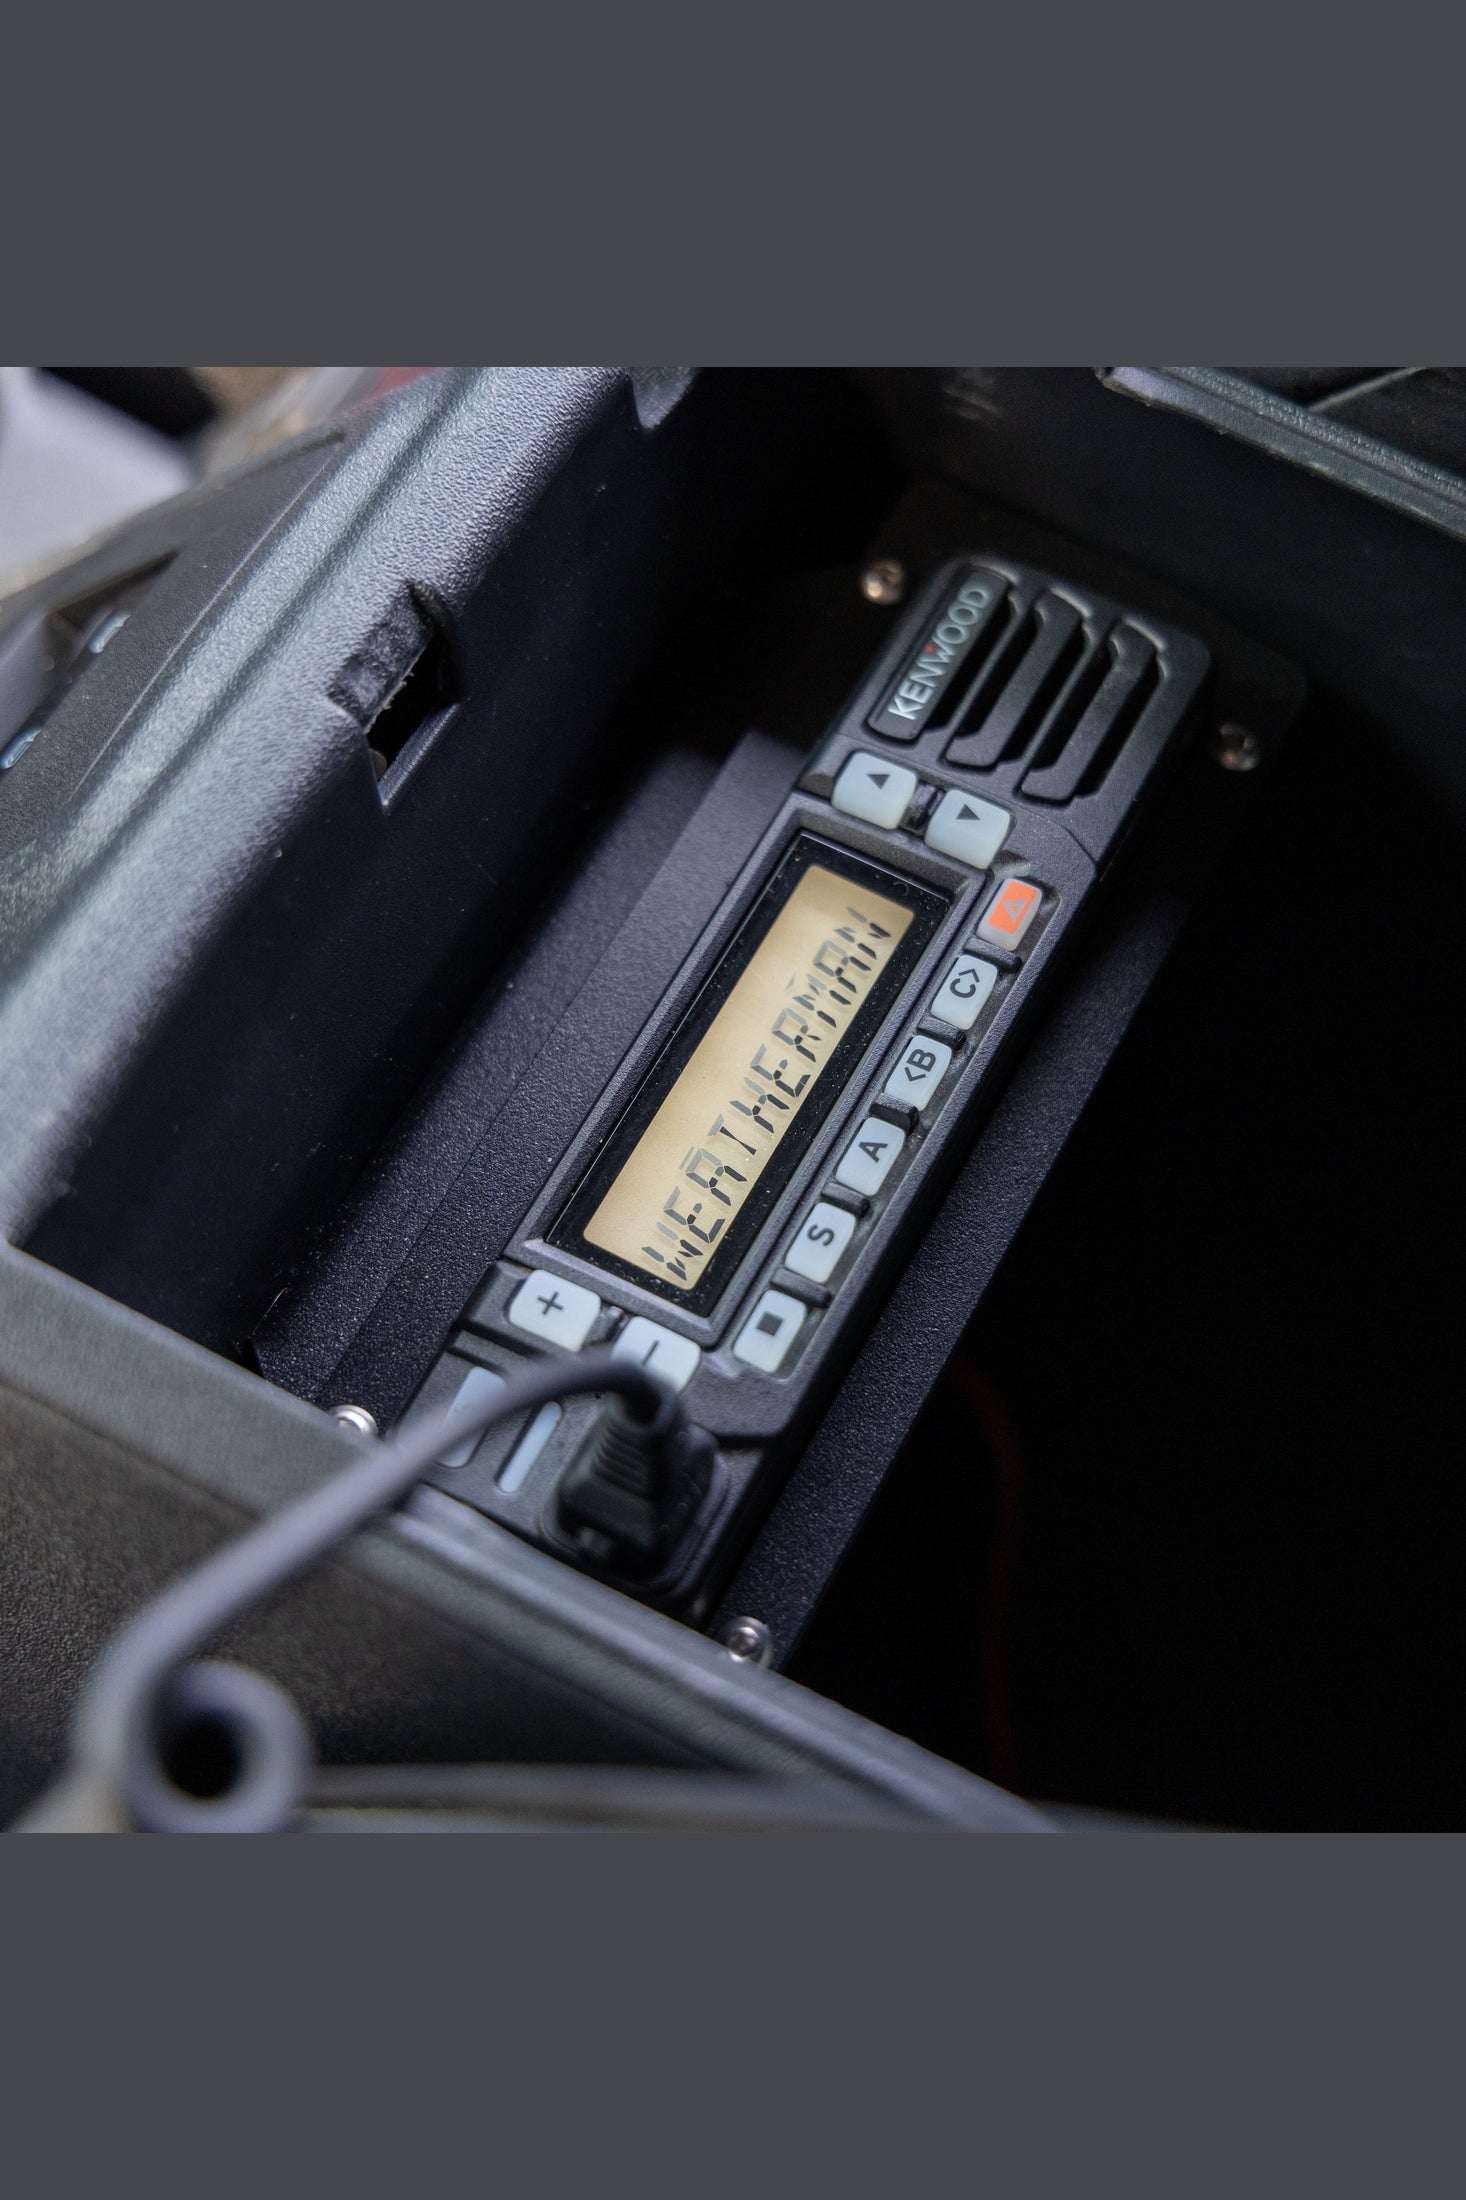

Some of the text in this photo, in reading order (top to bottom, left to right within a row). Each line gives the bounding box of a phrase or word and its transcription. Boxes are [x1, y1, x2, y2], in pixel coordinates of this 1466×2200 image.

[888, 586, 990, 720] KENWOOD
[641, 906, 891, 1280] WEATHERMAN
[863, 1141, 888, 1163] A
[808, 1224, 834, 1248] S
